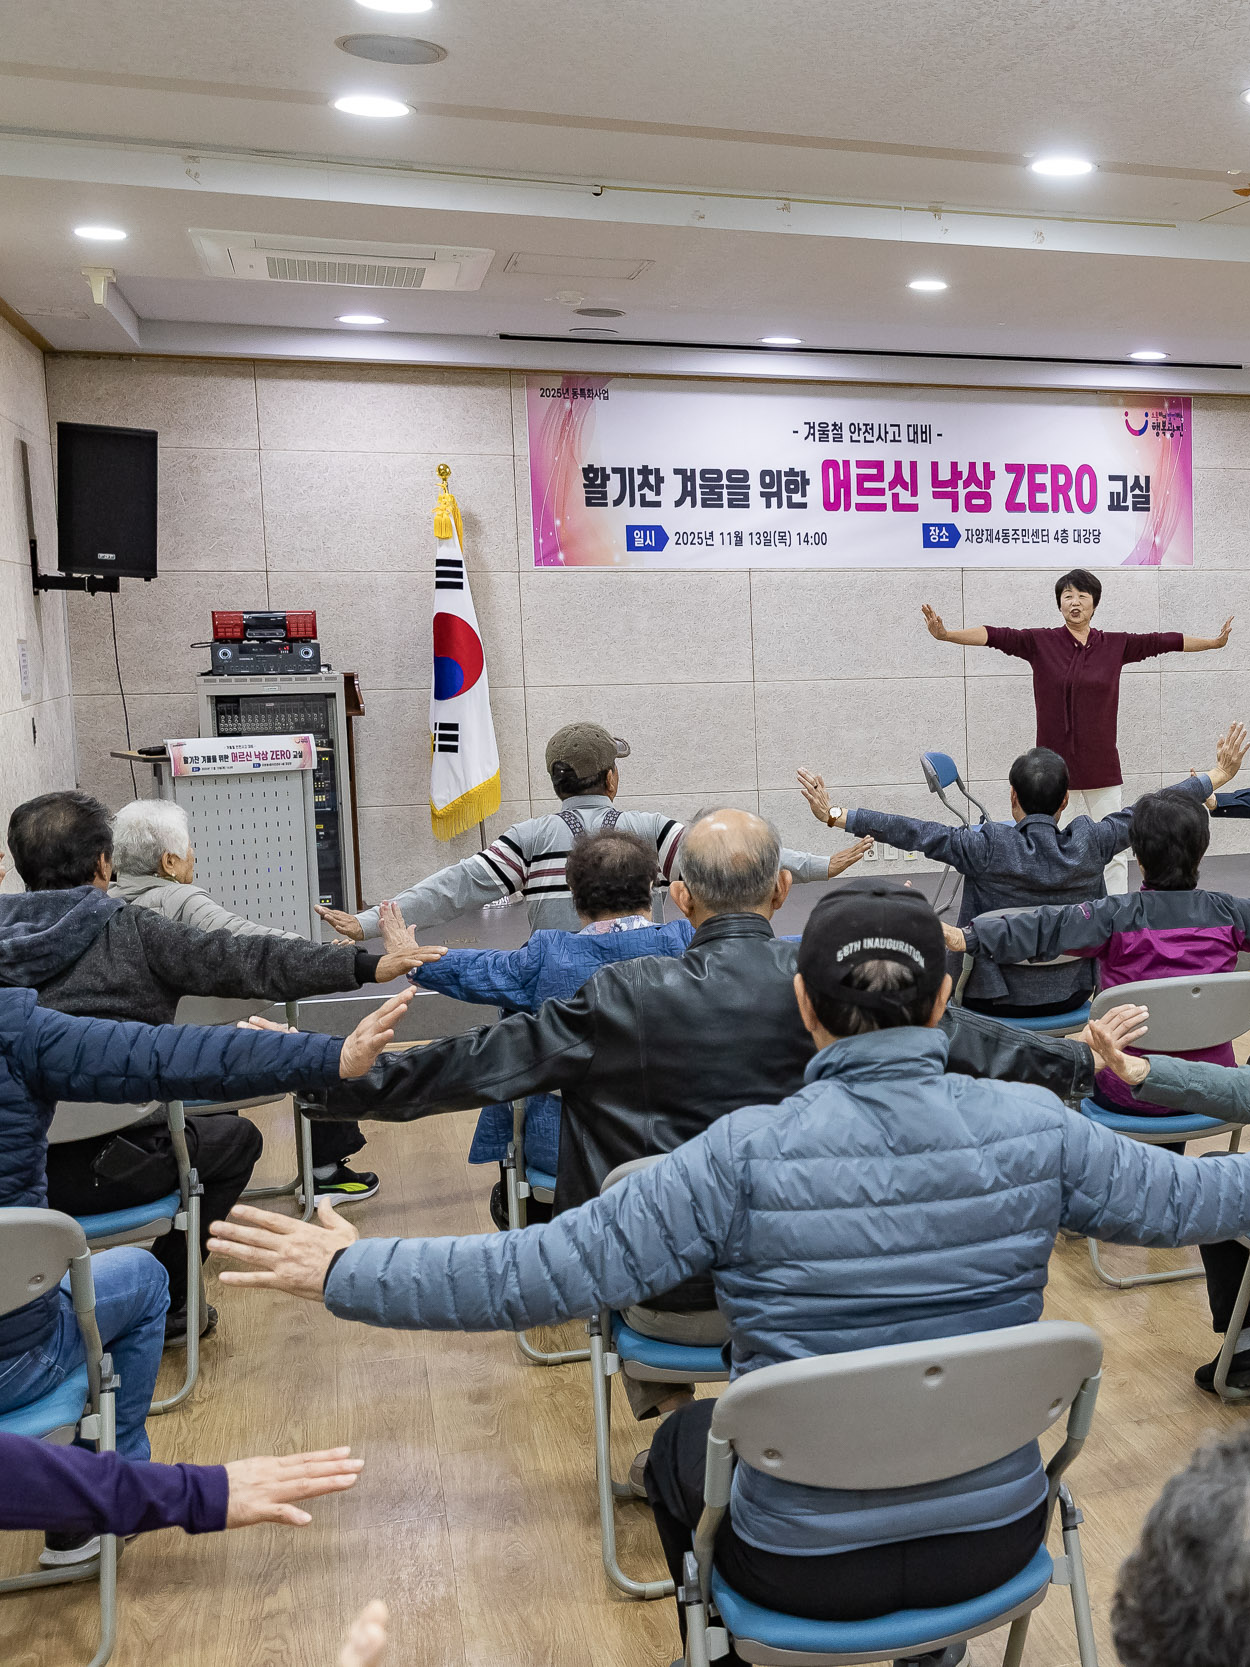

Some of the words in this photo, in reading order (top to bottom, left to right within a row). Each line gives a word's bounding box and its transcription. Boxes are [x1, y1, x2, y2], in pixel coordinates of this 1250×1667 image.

[540, 387, 570, 399] 2025년
[571, 388, 609, 400] 동특화사업
[803, 421, 844, 443] 겨울철
[849, 422, 902, 444] 안전사고
[906, 423, 932, 445] 대비
[581, 464, 665, 508] 활기찬
[672, 467, 751, 509] 겨울을
[759, 467, 811, 510] 위한
[821, 459, 919, 513] 어르신
[930, 461, 996, 514] 낙상
[1004, 463, 1098, 515] ZERO
[1107, 474, 1151, 512] 교실
[633, 530, 655, 547] 일시
[674, 531, 715, 547] 2025년
[719, 531, 744, 547] 11월
[749, 530, 792, 548] 13일(목)
[796, 532, 828, 546] 14:00
[929, 526, 950, 543] 장소
[964, 528, 1050, 544] 자양제4동주민센터
[1053, 530, 1069, 544] 4층
[1073, 529, 1102, 544] 대강당
[254, 750, 269, 761] 낙상
[270, 749, 292, 760] ZERO
[863, 937, 925, 969] INAUGURATION
